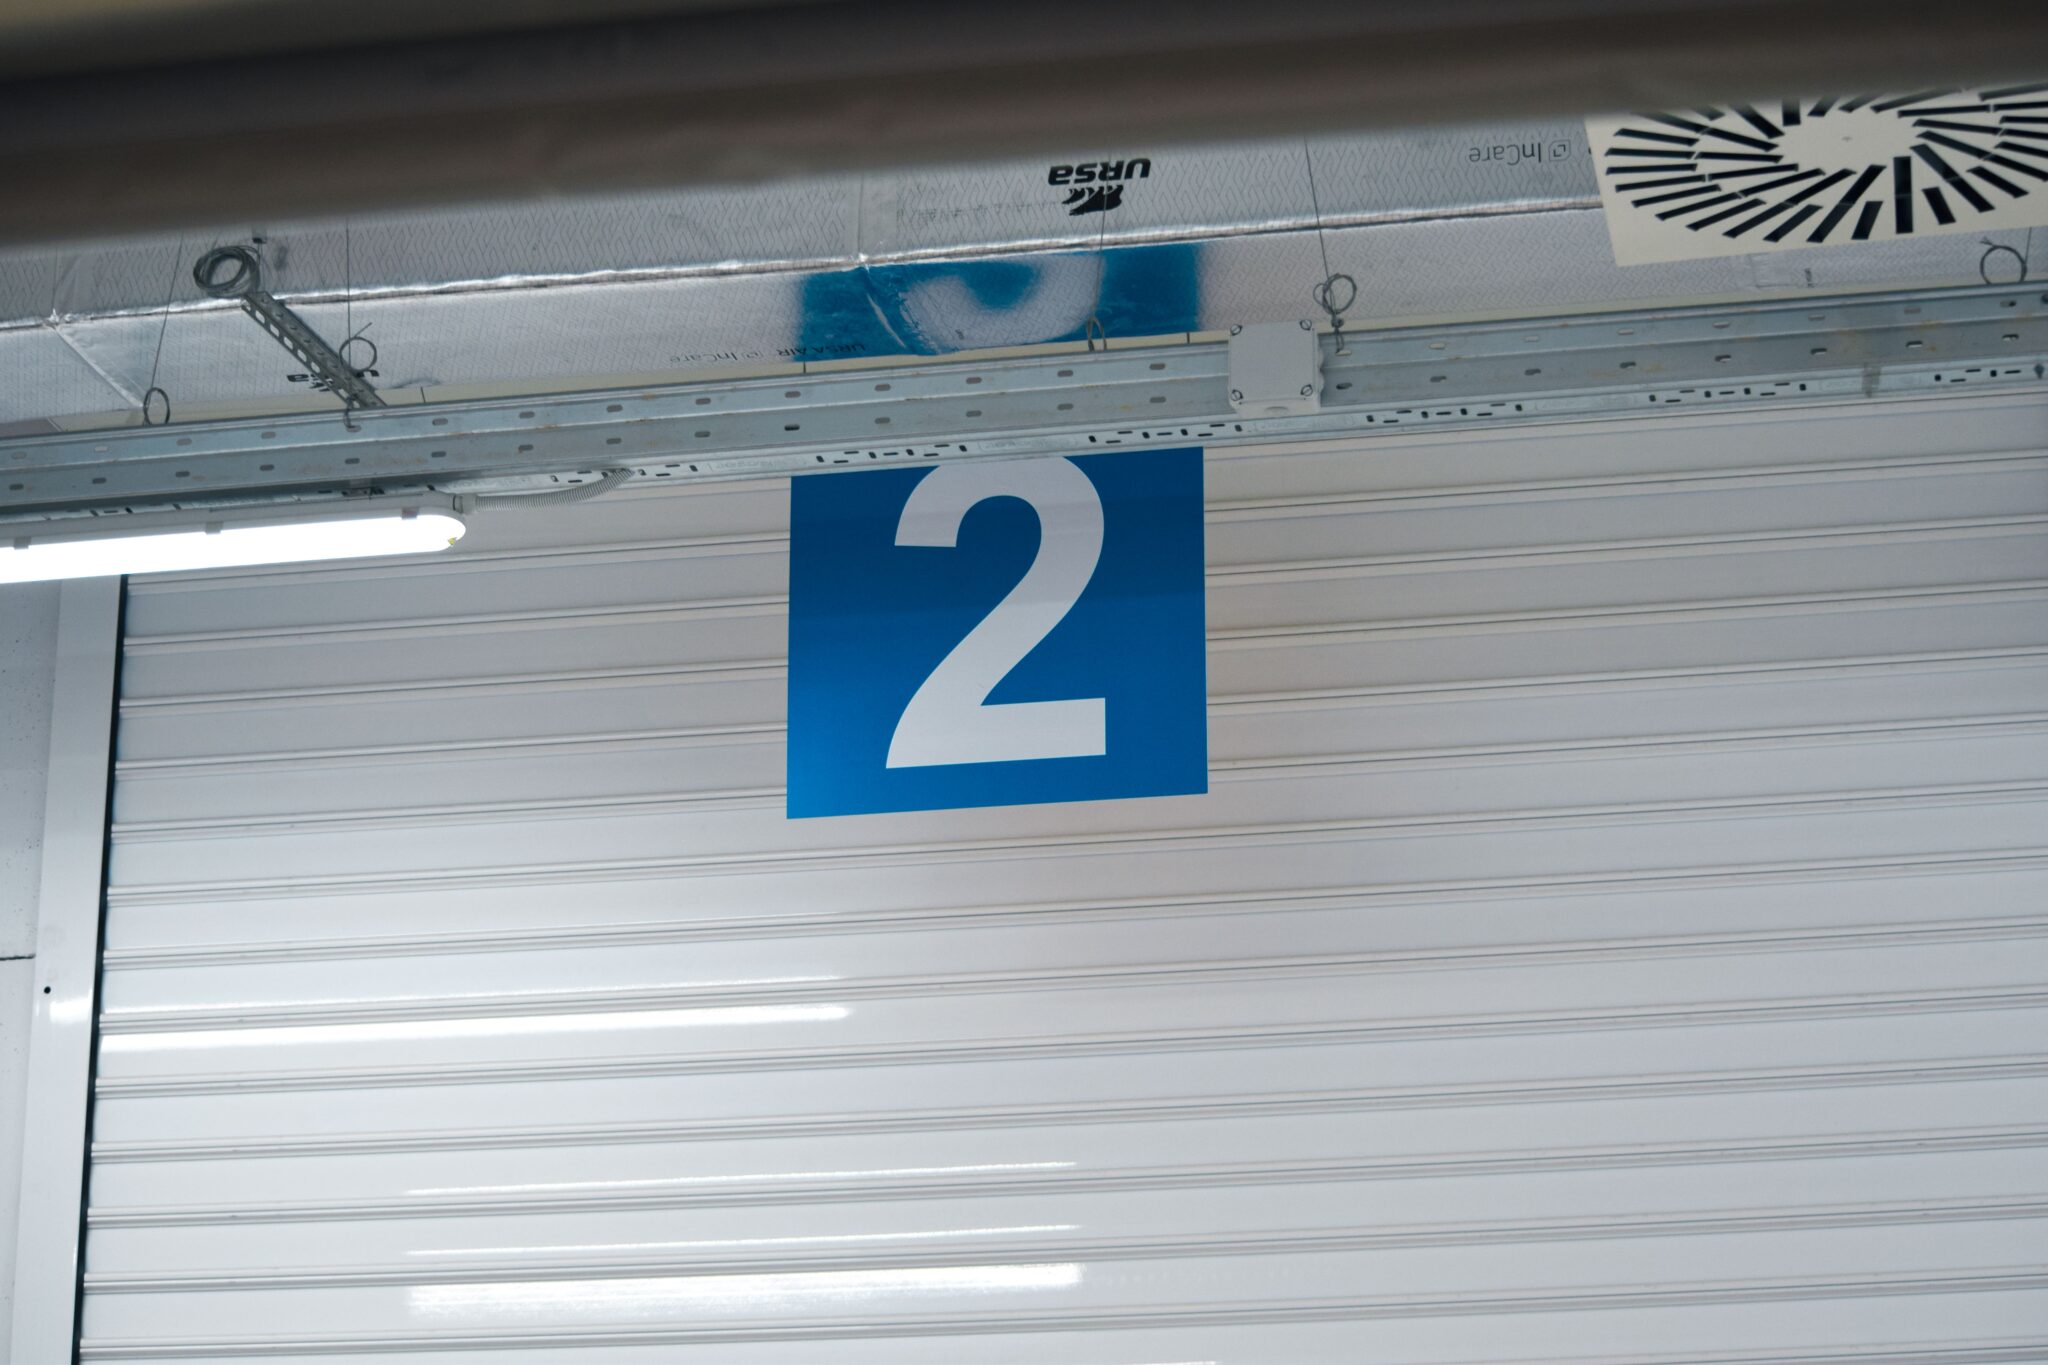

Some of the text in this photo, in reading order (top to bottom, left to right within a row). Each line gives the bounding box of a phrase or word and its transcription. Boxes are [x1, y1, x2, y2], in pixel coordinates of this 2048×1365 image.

[1468, 142, 1542, 166] InCare
[670, 352, 738, 362] InCare
[776, 347, 807, 356] AIR
[886, 456, 1106, 769] 2
